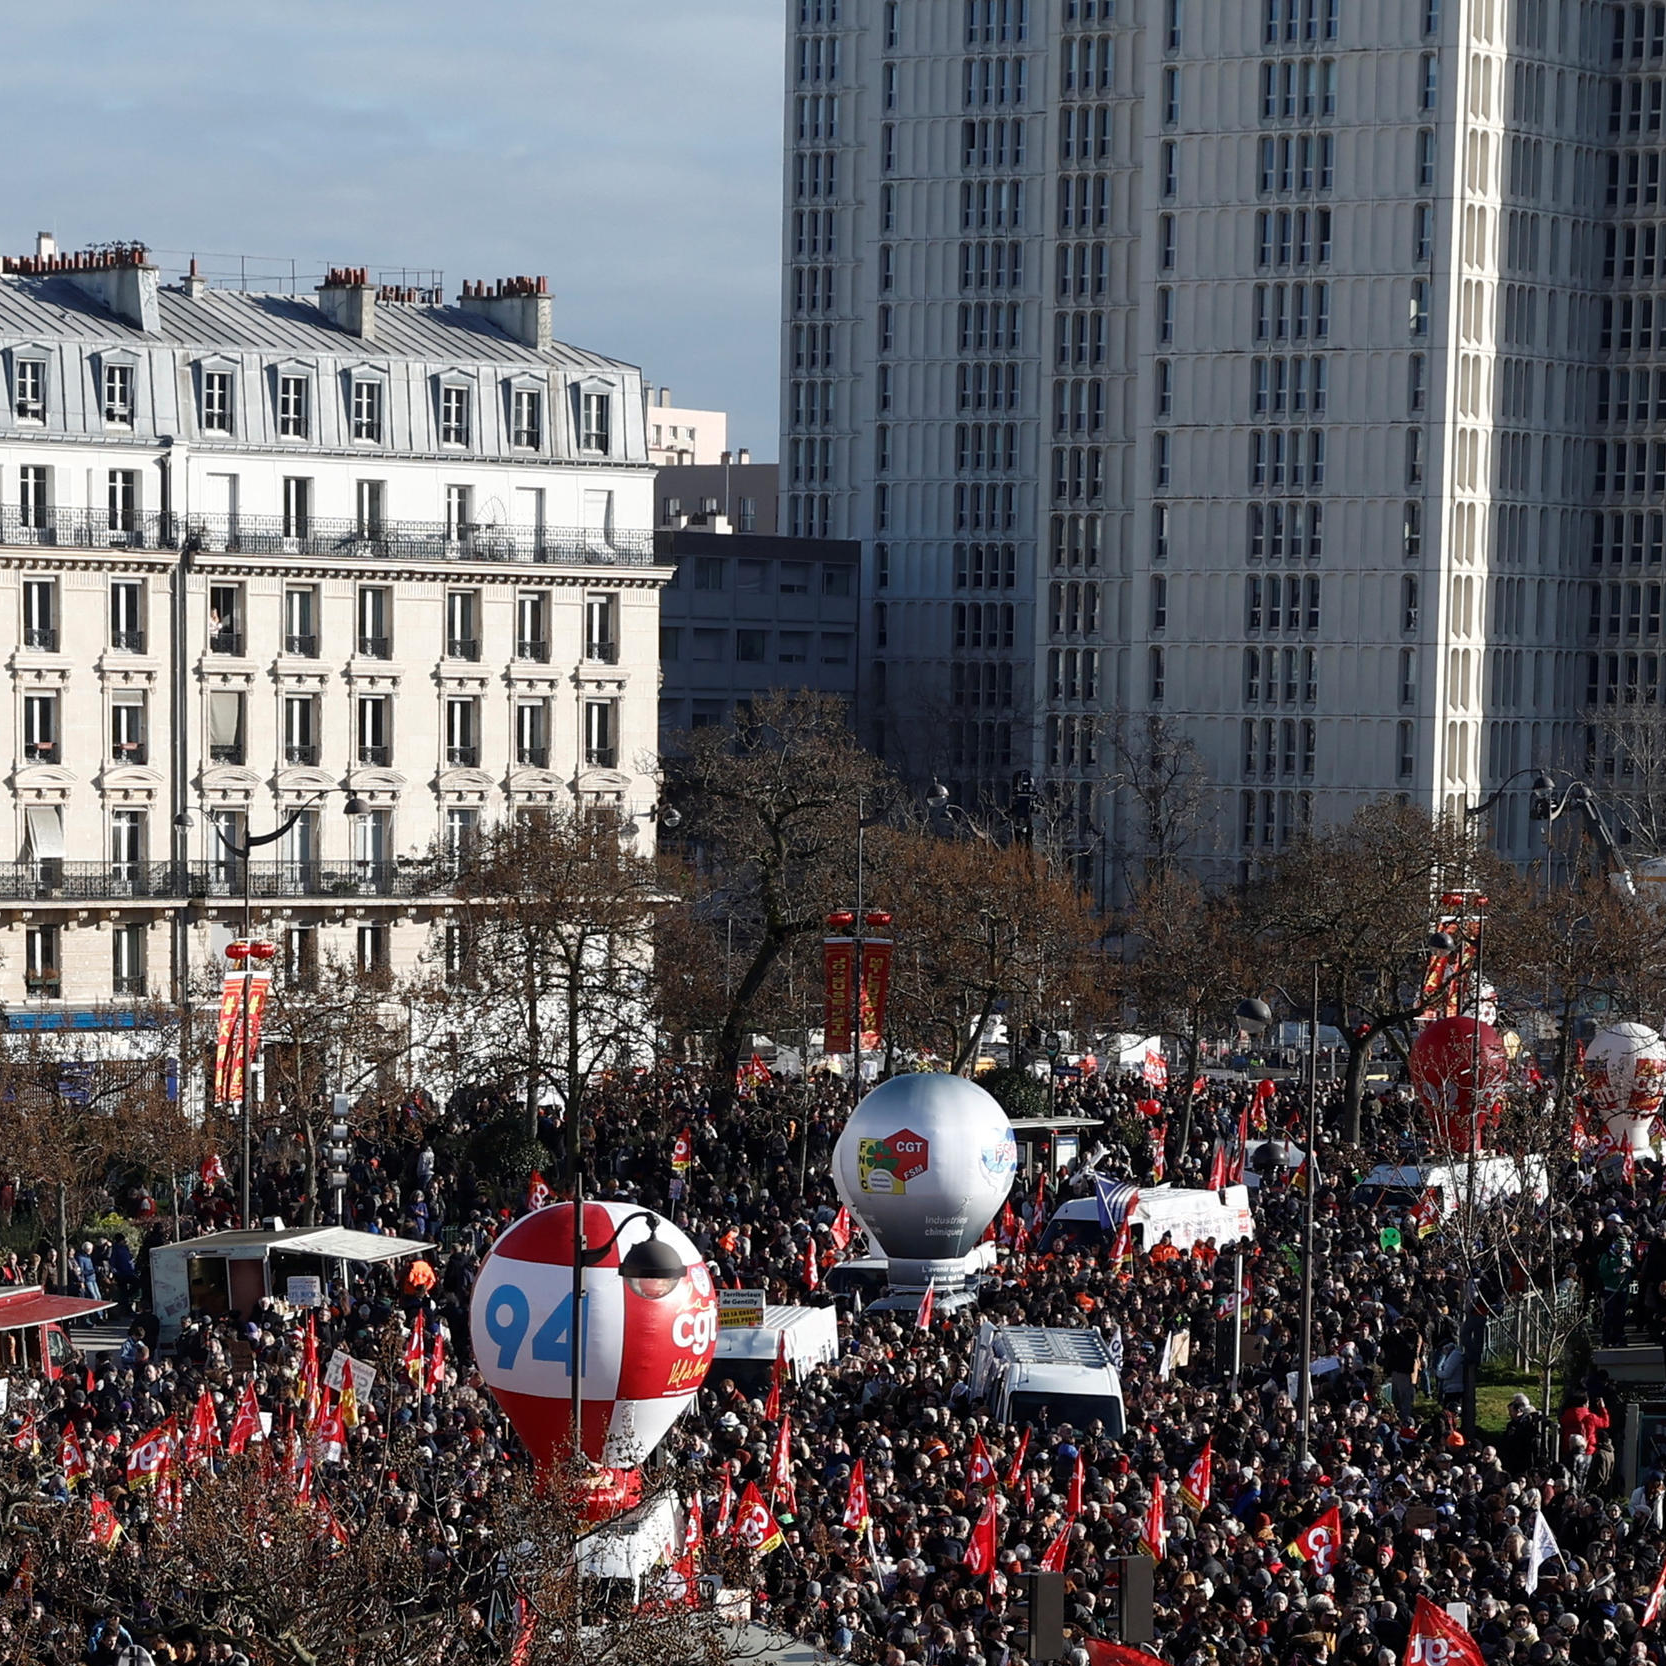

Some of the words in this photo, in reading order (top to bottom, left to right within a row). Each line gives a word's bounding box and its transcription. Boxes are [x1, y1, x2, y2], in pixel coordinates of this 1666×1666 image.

[896, 1141, 923, 1153] CGT
[903, 1164, 924, 1180] FSM
[925, 1215, 968, 1224] Industries
[925, 1228, 964, 1238] chimiques
[486, 1284, 589, 1364] 94
[673, 1303, 717, 1354] cgt
